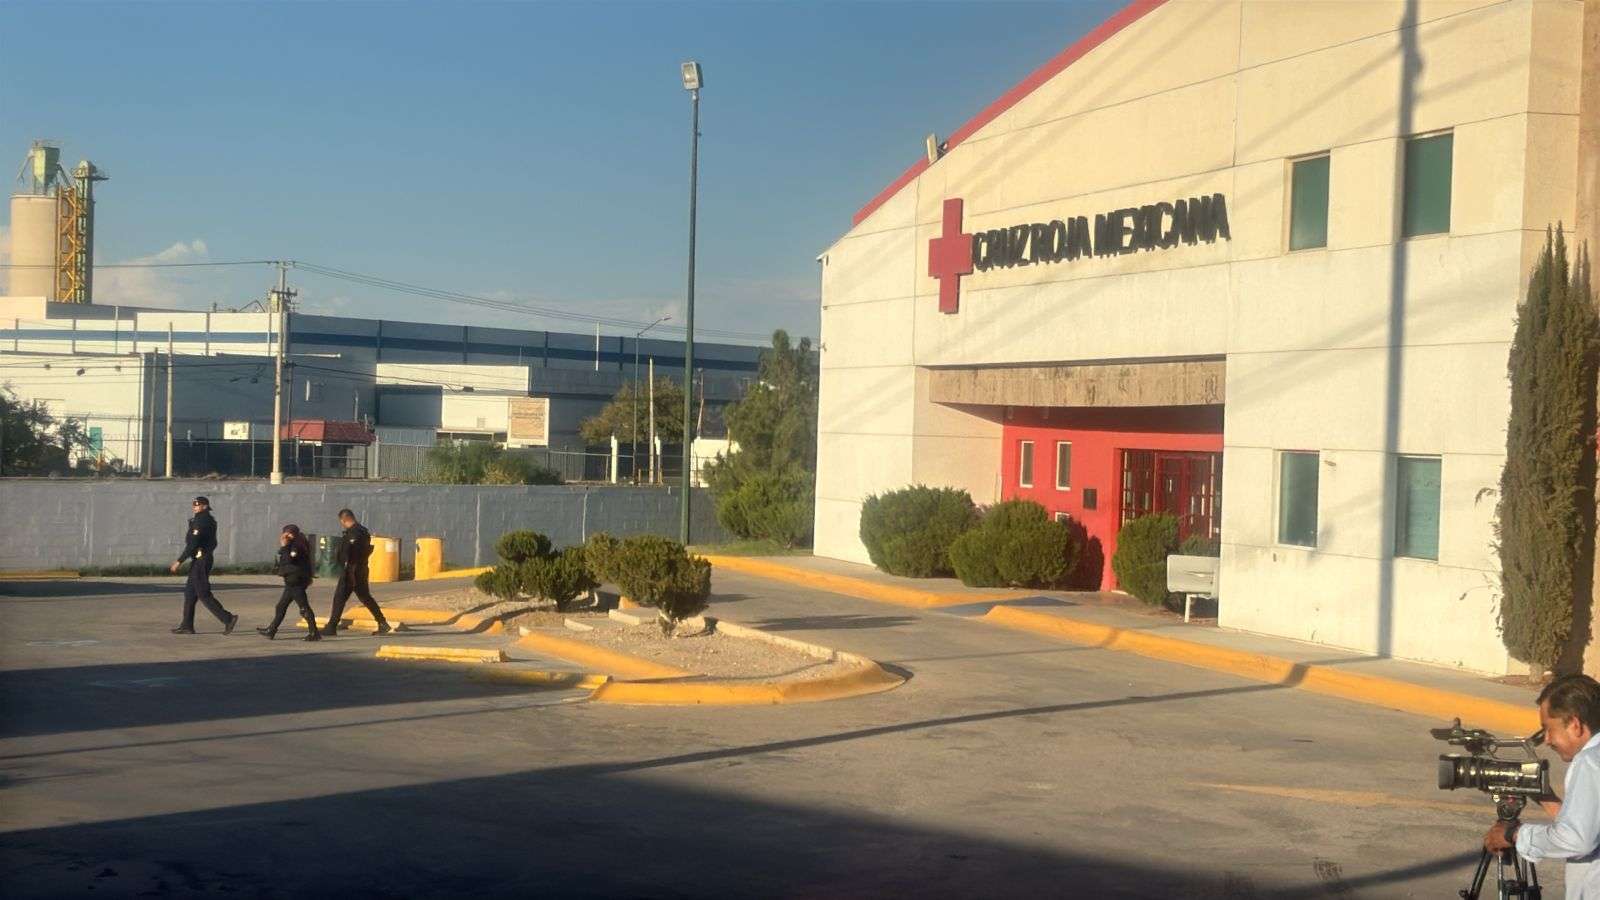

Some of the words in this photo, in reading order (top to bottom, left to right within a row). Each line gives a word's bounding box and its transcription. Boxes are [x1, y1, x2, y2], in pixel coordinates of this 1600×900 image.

[973, 224, 1030, 272] CRUZ
[1030, 216, 1092, 265] ROJA
[1094, 193, 1231, 259] MEXICANA
